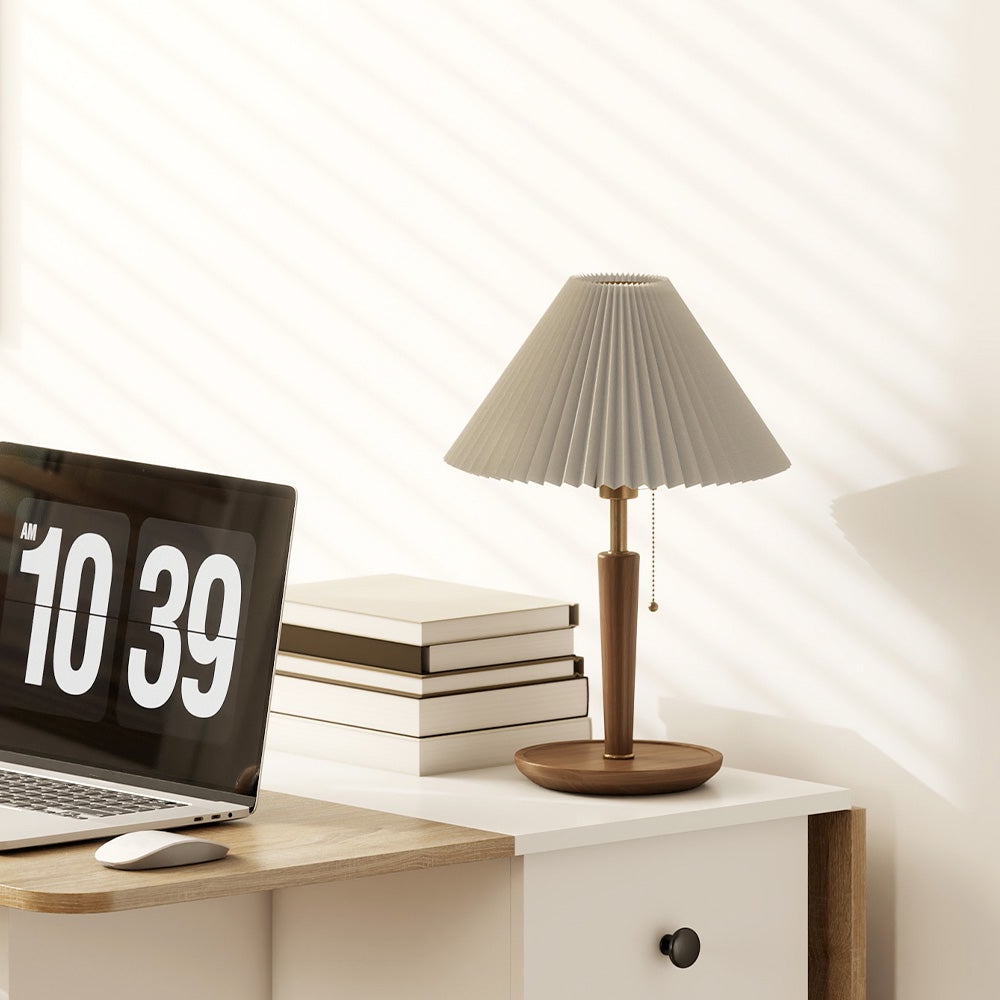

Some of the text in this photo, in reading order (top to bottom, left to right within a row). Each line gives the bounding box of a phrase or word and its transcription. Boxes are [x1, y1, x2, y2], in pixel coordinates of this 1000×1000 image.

[20, 521, 38, 541] AM
[20, 526, 242, 719] 10 39
